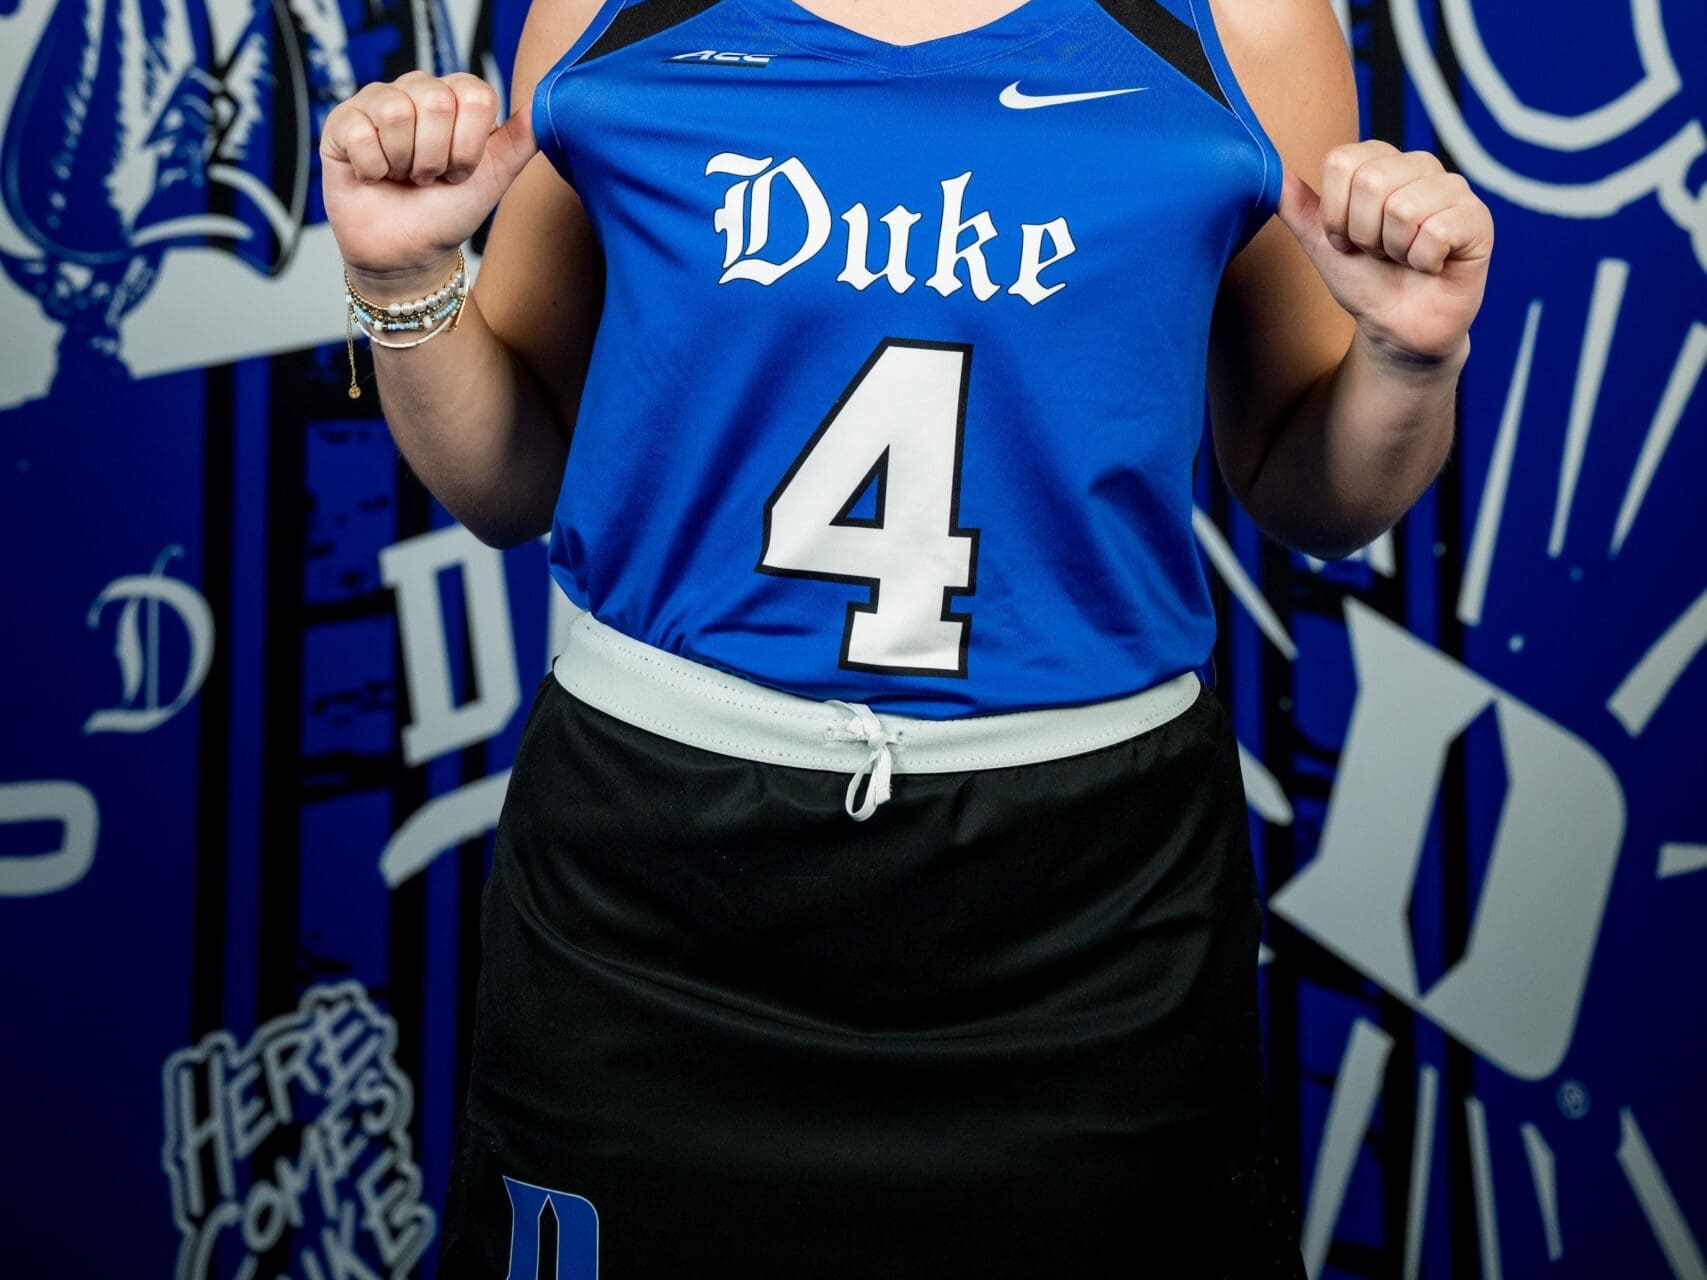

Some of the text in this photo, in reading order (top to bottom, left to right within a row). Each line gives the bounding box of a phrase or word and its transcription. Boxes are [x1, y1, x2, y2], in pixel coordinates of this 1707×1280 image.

[670, 49, 778, 64] ACC
[704, 152, 1077, 307] Duke
[755, 336, 981, 679] 4
[84, 545, 216, 735] D
[1268, 596, 1628, 1082] D
[178, 999, 388, 1218] HERE
